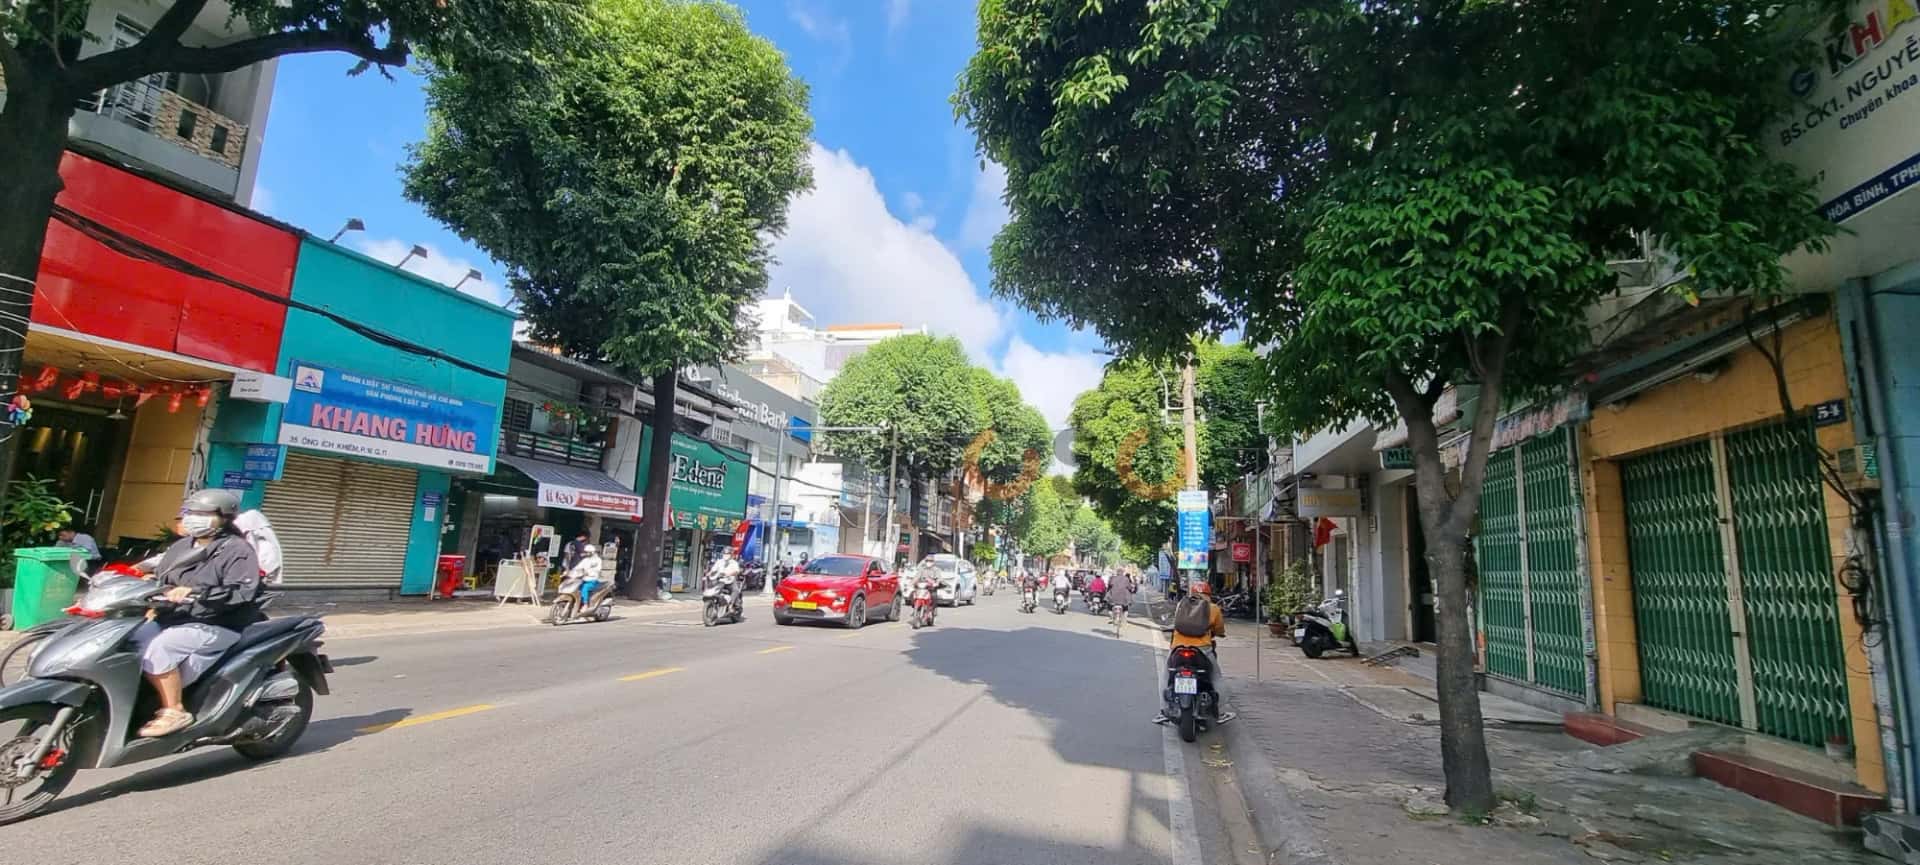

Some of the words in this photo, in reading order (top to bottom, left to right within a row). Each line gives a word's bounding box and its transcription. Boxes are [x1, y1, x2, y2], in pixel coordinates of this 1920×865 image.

[1825, 0, 1920, 75] KHA
[1846, 34, 1920, 102] NGUYỄ
[1839, 95, 1884, 130] Chuyên
[1884, 74, 1919, 101] khoa
[1890, 161, 1920, 187] TPH
[310, 402, 407, 442] KHANG
[761, 400, 789, 429] Bank
[671, 453, 727, 490] Edena
